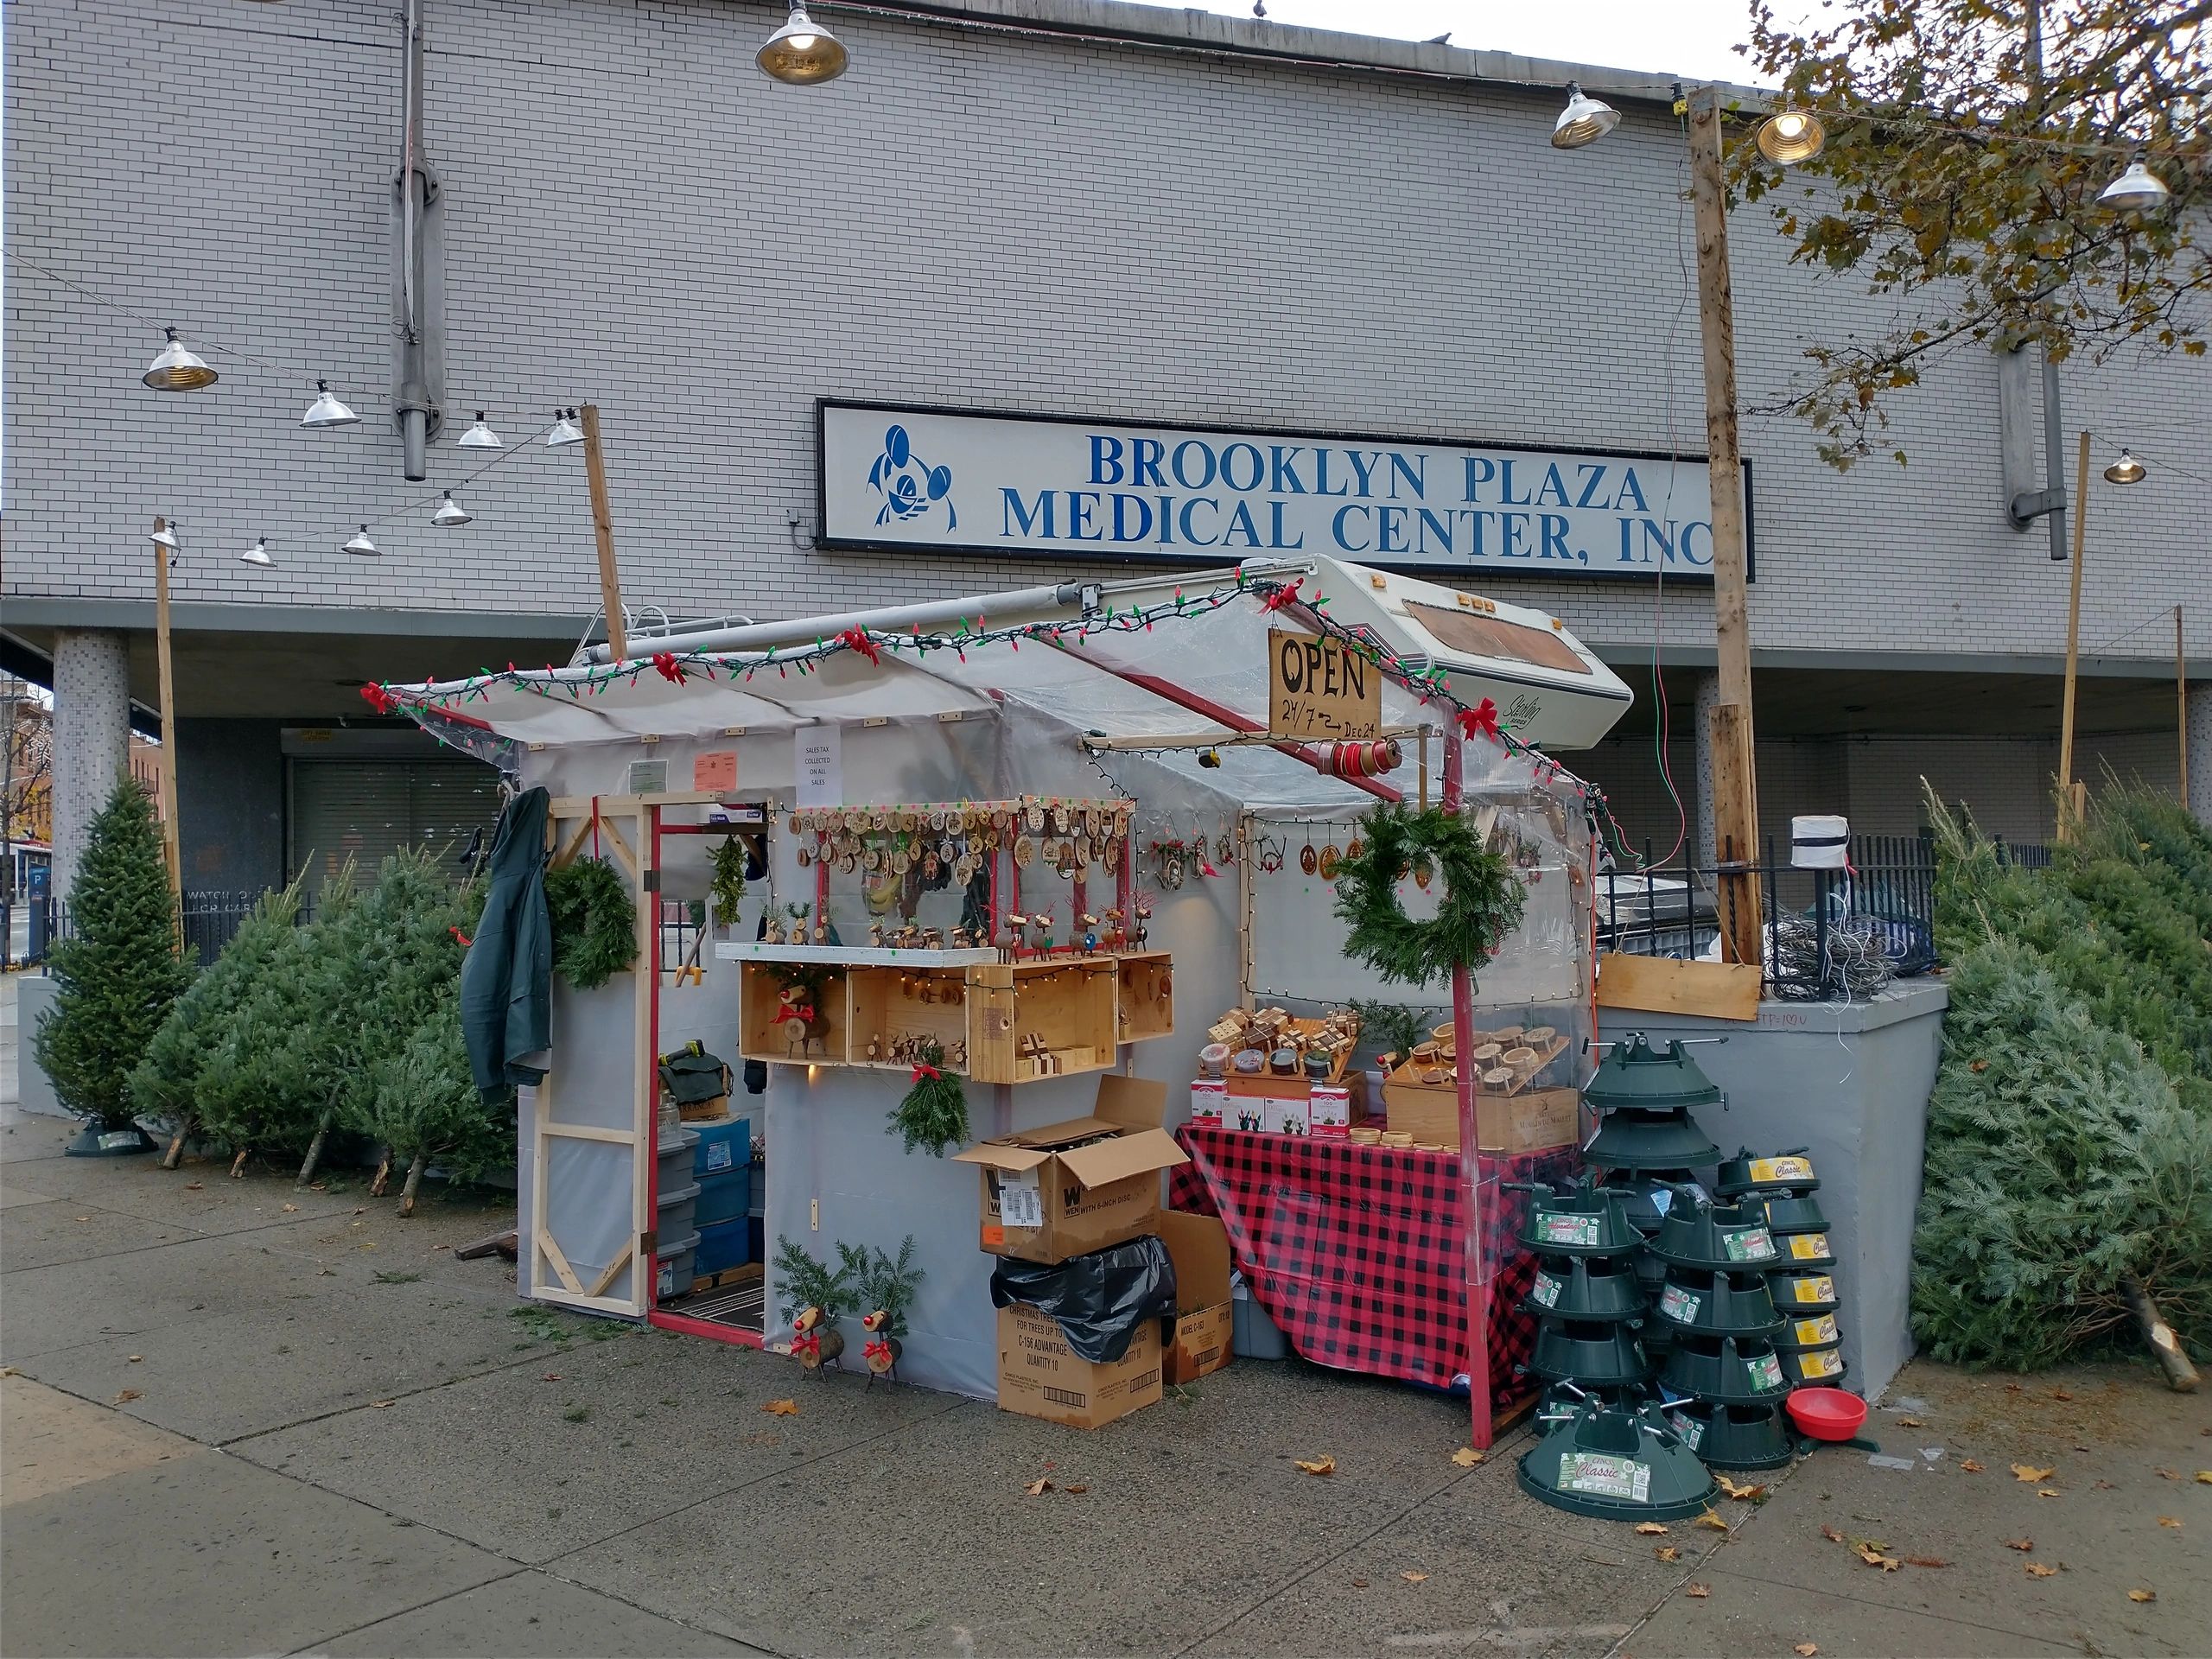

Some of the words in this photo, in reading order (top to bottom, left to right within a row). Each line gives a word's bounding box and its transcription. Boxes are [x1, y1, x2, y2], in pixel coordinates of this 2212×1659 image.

[1085, 435, 1429, 500] BROOKLYN
[1460, 456, 1650, 512] PLAZA
[1001, 488, 1304, 550] MEDICAL
[1332, 504, 1590, 566] CENTER,
[1281, 639, 1365, 700] OPEN
[1282, 698, 1316, 731] 24/7
[35, 874, 41, 884] P
[188, 890, 230, 899] WATCH
[1775, 1165, 1801, 1178] Classic
[1065, 1206, 1079, 1217] WEN
[1080, 1204, 1096, 1215] WITH
[1096, 1195, 1116, 1210] 6-INCH
[1009, 1305, 1039, 1320] CHRISTMAS
[1016, 1319, 1027, 1331] FOR
[1028, 1322, 1045, 1335] TREES
[1045, 1325, 1054, 1337] UP
[1055, 1328, 1063, 1338] TO
[1180, 1324, 1193, 1337] MODEL
[1034, 1338, 1068, 1357] ADVANTAGE
[1027, 1353, 1052, 1370] QUANTITY
[1052, 1359, 1058, 1372] 10
[1575, 1461, 1619, 1478] Classic
